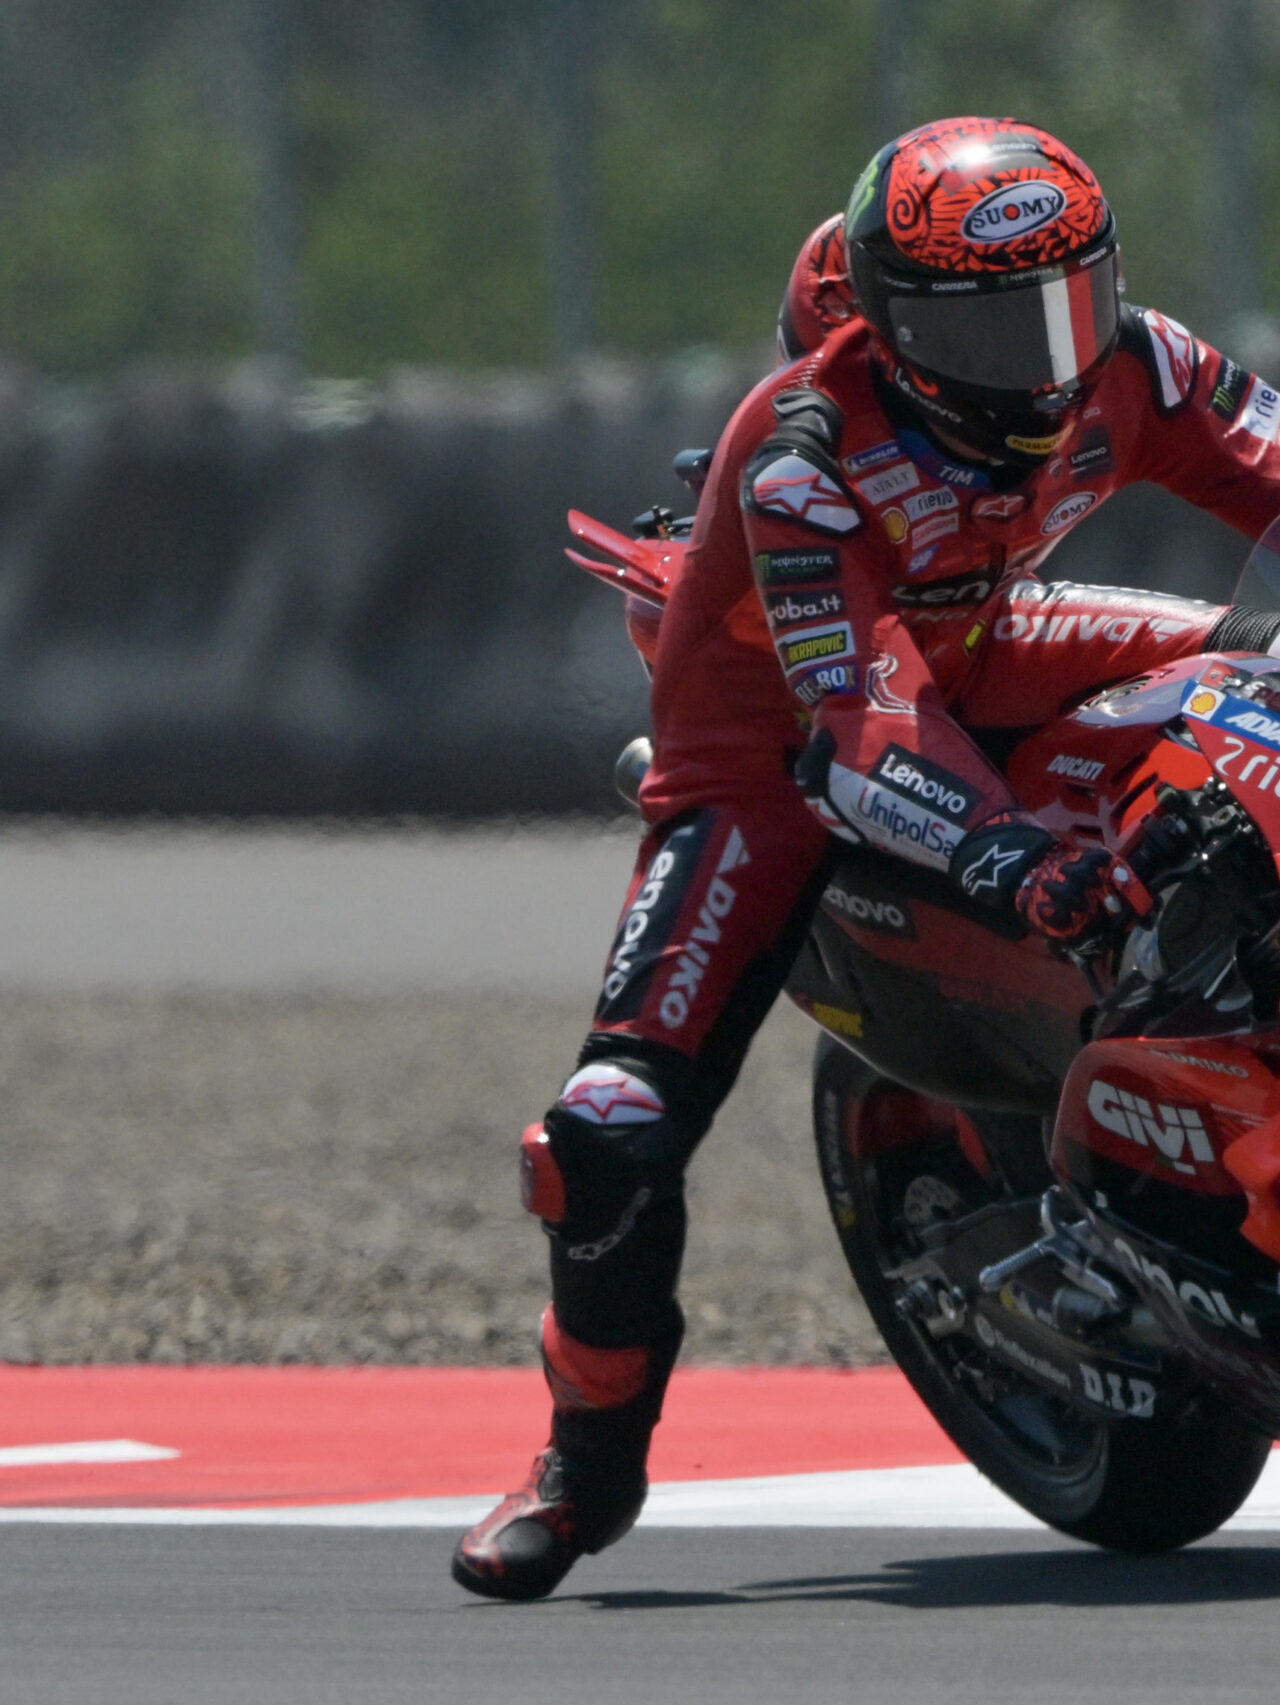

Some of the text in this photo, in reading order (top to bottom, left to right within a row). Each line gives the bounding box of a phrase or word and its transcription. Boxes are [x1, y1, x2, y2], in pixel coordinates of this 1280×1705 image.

[971, 194, 1058, 229] SUOMY
[931, 280, 979, 291] CARRERA
[1255, 389, 1279, 418] rie
[1070, 446, 1108, 465] Lenovo
[870, 471, 910, 497] ATALY
[938, 465, 975, 486] TIM
[1045, 498, 1092, 529] SUOMY
[770, 554, 834, 567] MONSTER
[891, 580, 991, 602] Len
[767, 593, 841, 627] ruba.it
[1047, 754, 1107, 781] DUCATI
[879, 753, 967, 815] Lenovo
[858, 786, 953, 857] UnipolSa
[824, 883, 906, 928] enovo
[659, 876, 737, 1029] DAIKO
[1087, 1079, 1215, 1163] GIVI
